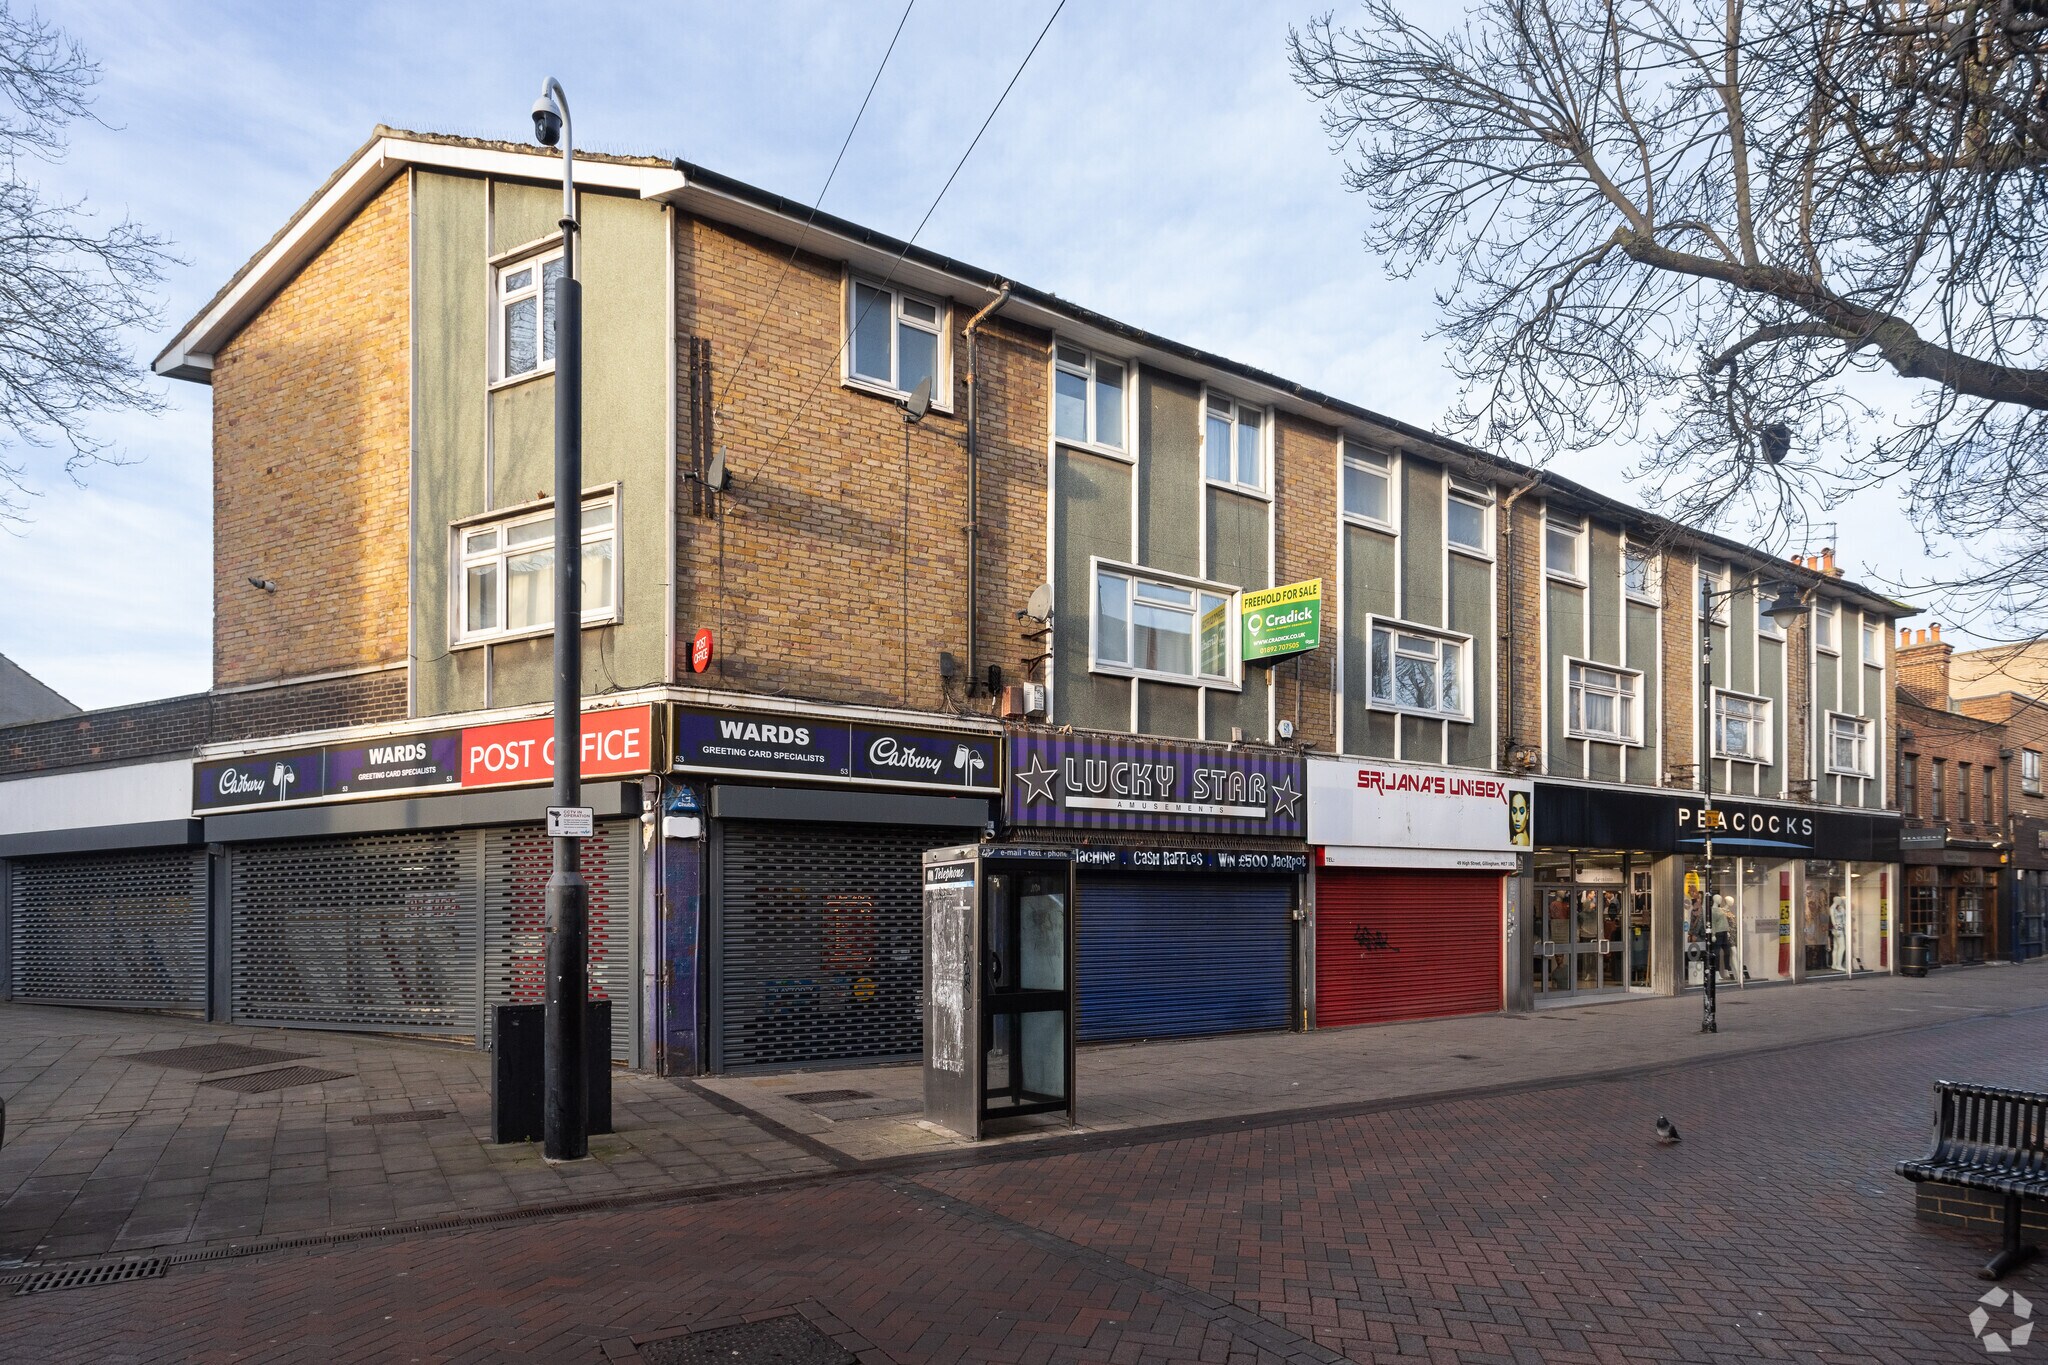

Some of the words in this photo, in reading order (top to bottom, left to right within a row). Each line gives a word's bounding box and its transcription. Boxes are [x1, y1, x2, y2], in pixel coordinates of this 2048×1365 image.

[1244, 592, 1281, 608] FREEHOLD
[1282, 589, 1298, 601] FOR
[1298, 584, 1317, 598] SALE
[1266, 607, 1313, 627] Cradick
[719, 720, 810, 746] WARDS
[368, 743, 427, 765] WARDS
[469, 739, 536, 774] POST
[542, 728, 640, 766] OFICE
[675, 755, 685, 763] 53
[702, 745, 747, 758] GREETING
[748, 749, 772, 760] CARD
[773, 751, 825, 763] SPECIALISTS
[869, 737, 943, 775] Cadbury
[219, 768, 265, 795] Cadbury
[357, 771, 385, 781] GREETING
[386, 769, 401, 778] CARD
[402, 766, 437, 777] SPECIALISTS
[840, 768, 849, 776] 53
[1065, 757, 1174, 797] LUCKY
[1193, 768, 1266, 803] STAR
[1117, 801, 1225, 813] AMUSEMENTS
[1678, 808, 1813, 836] PEACOCKS
[1000, 849, 1022, 857] e-mail
[1047, 850, 1067, 860] phone
[1238, 854, 1268, 868] £500
[934, 866, 965, 881] Telephone
